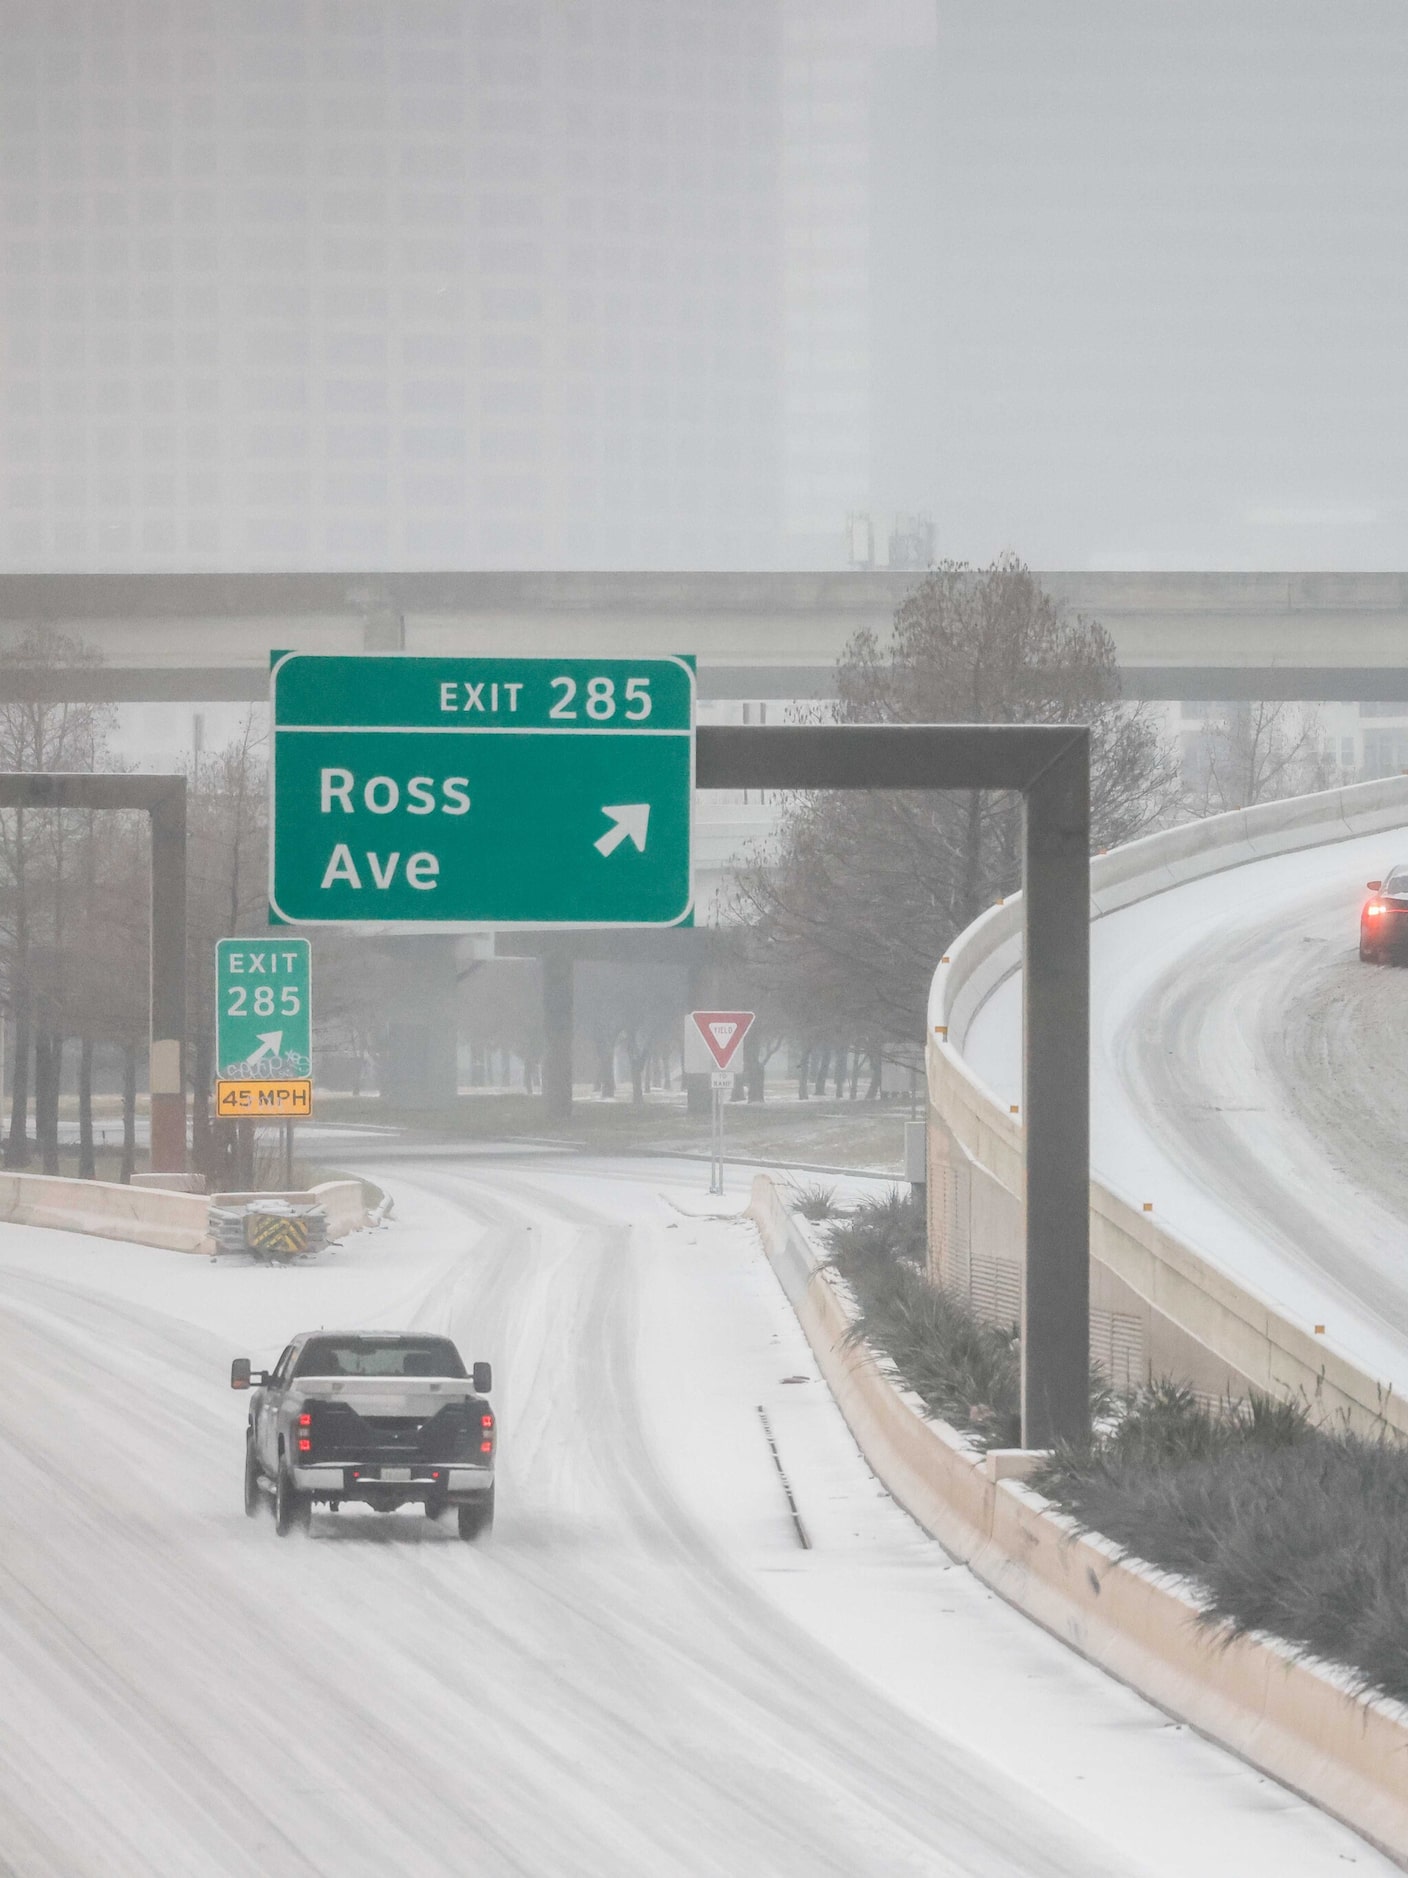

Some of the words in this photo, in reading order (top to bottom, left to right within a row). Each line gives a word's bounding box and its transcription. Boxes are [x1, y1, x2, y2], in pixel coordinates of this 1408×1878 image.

[441, 683, 523, 711] EXIT
[549, 677, 652, 720] 285
[321, 768, 470, 815] Ross
[321, 844, 439, 890] Ave
[230, 953, 297, 973] EXIT
[227, 986, 300, 1016] 285
[223, 1091, 251, 1106] 45
[259, 1090, 306, 1106] MPH
